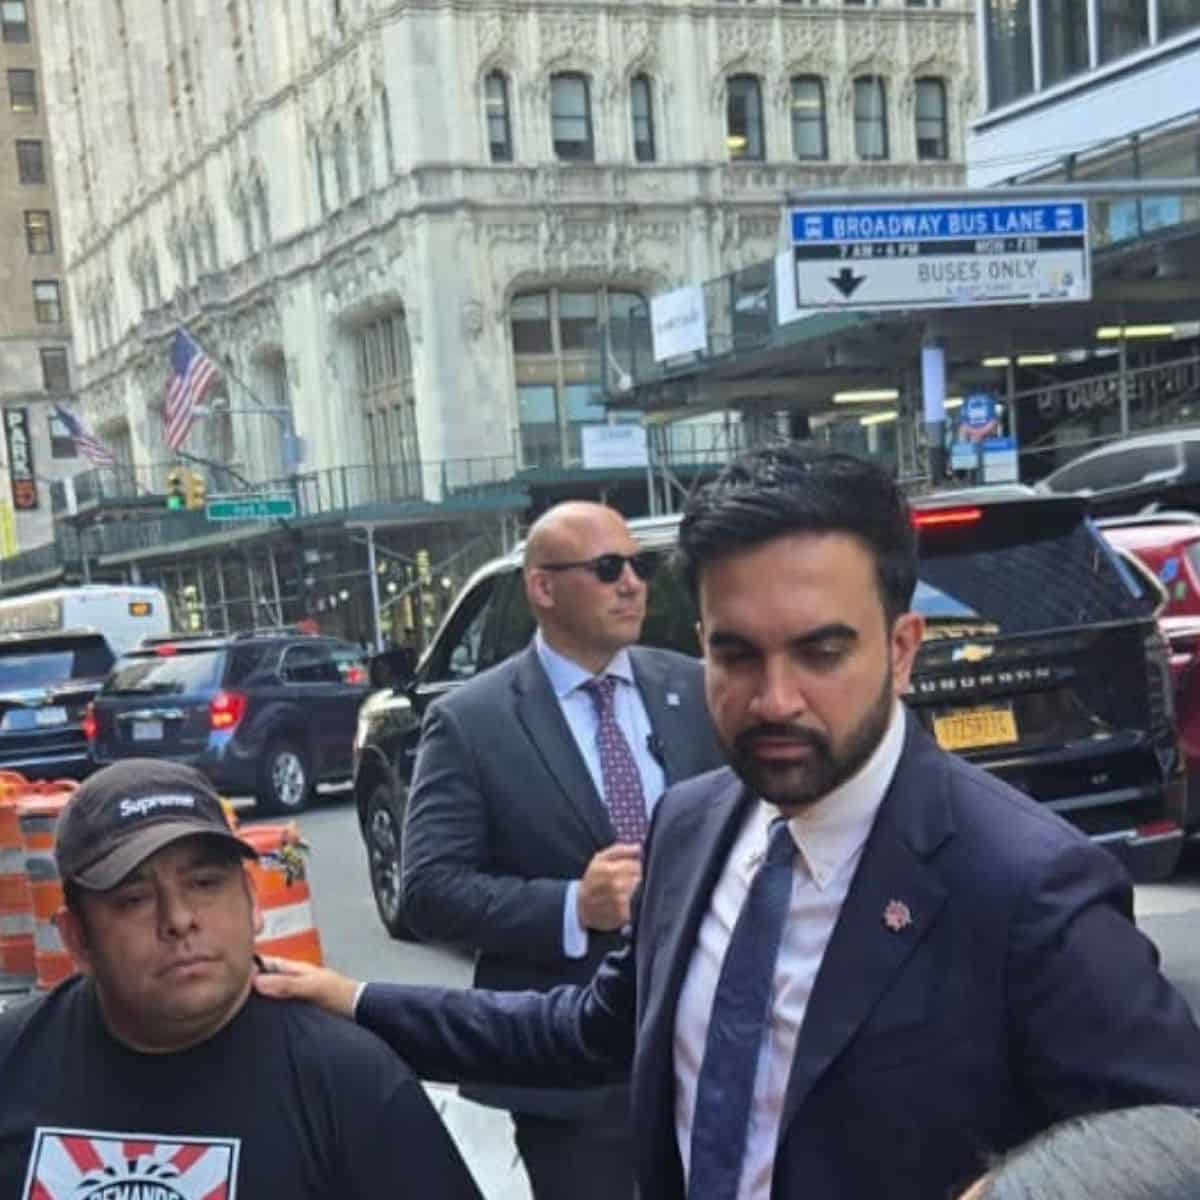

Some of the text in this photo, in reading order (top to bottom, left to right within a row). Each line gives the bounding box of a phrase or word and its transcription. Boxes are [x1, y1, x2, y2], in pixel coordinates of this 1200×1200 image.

[833, 210, 1046, 239] BROADWAY BUS LANE
[918, 258, 1038, 283] BUSES ONLY
